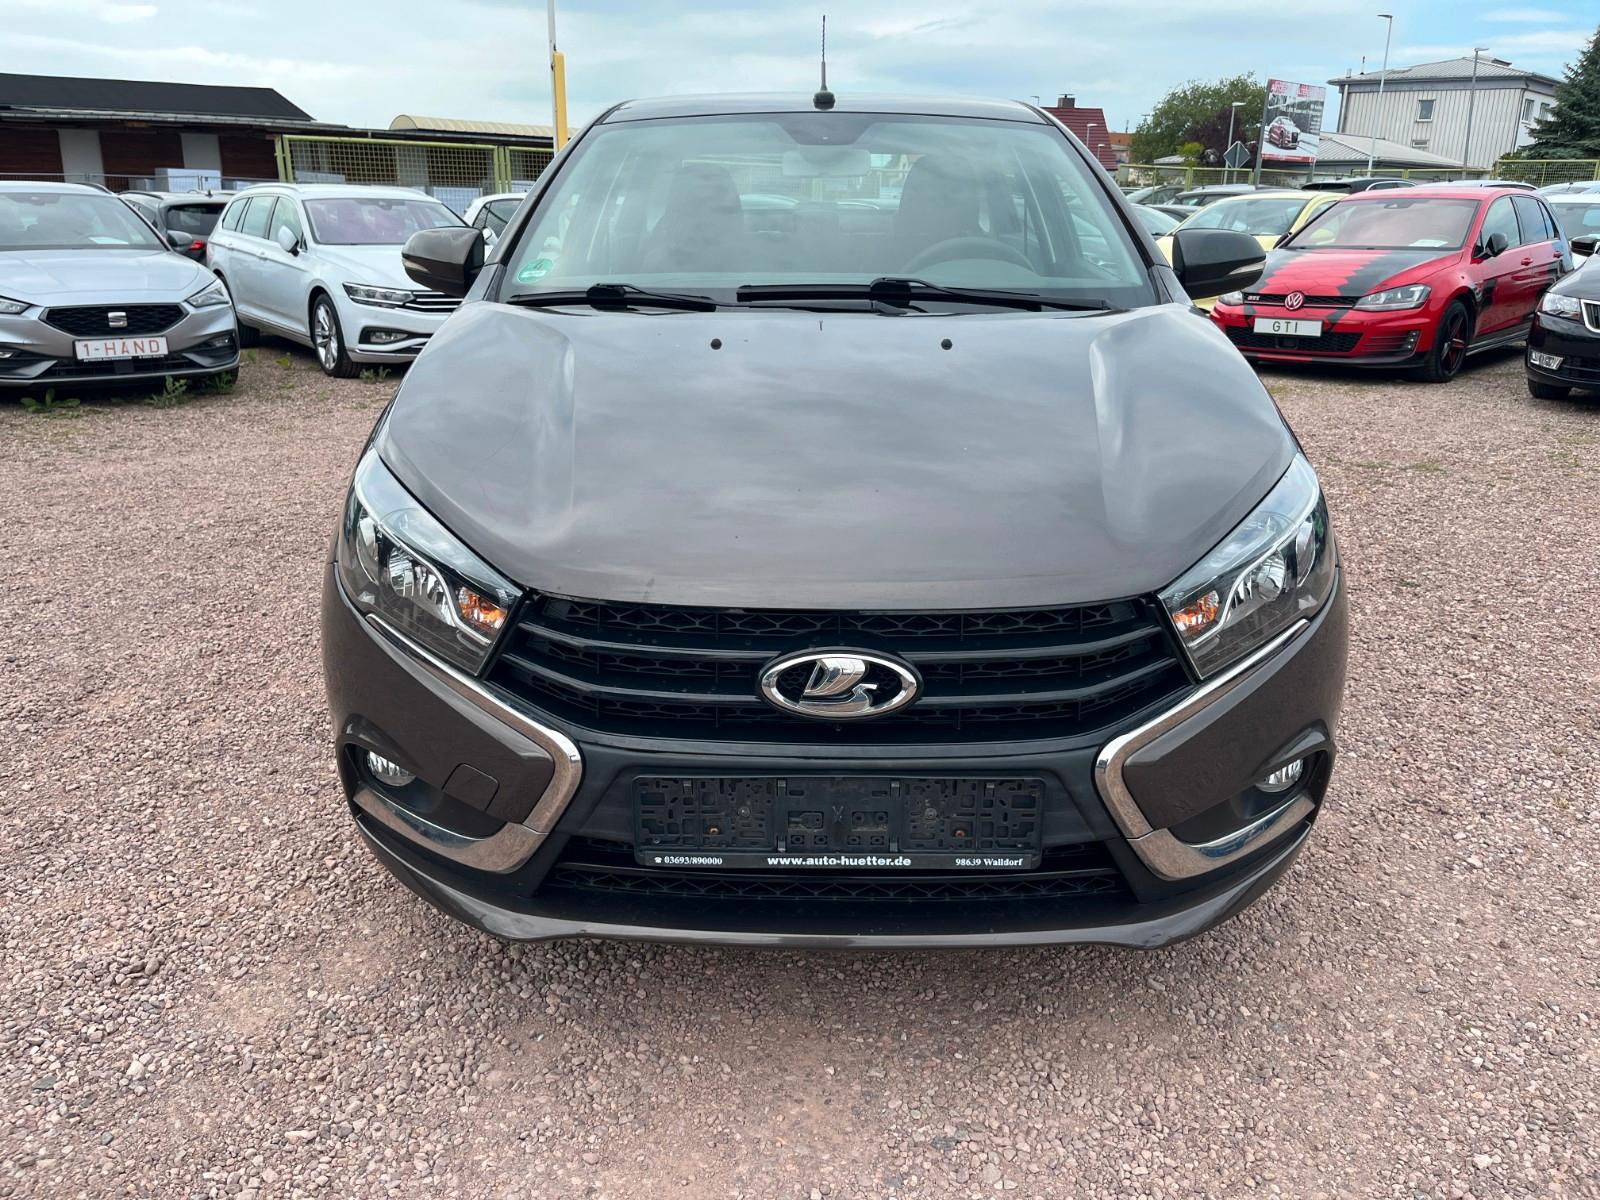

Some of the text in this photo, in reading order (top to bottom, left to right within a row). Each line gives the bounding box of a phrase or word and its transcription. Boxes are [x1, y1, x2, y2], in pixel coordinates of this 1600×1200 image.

[1272, 320, 1298, 334] GTI
[83, 339, 161, 357] 1-HAND
[664, 855, 723, 866] 03693/890000
[767, 855, 912, 866] www.auto-huetter.de
[955, 857, 1024, 867] 98639 Walldorf
